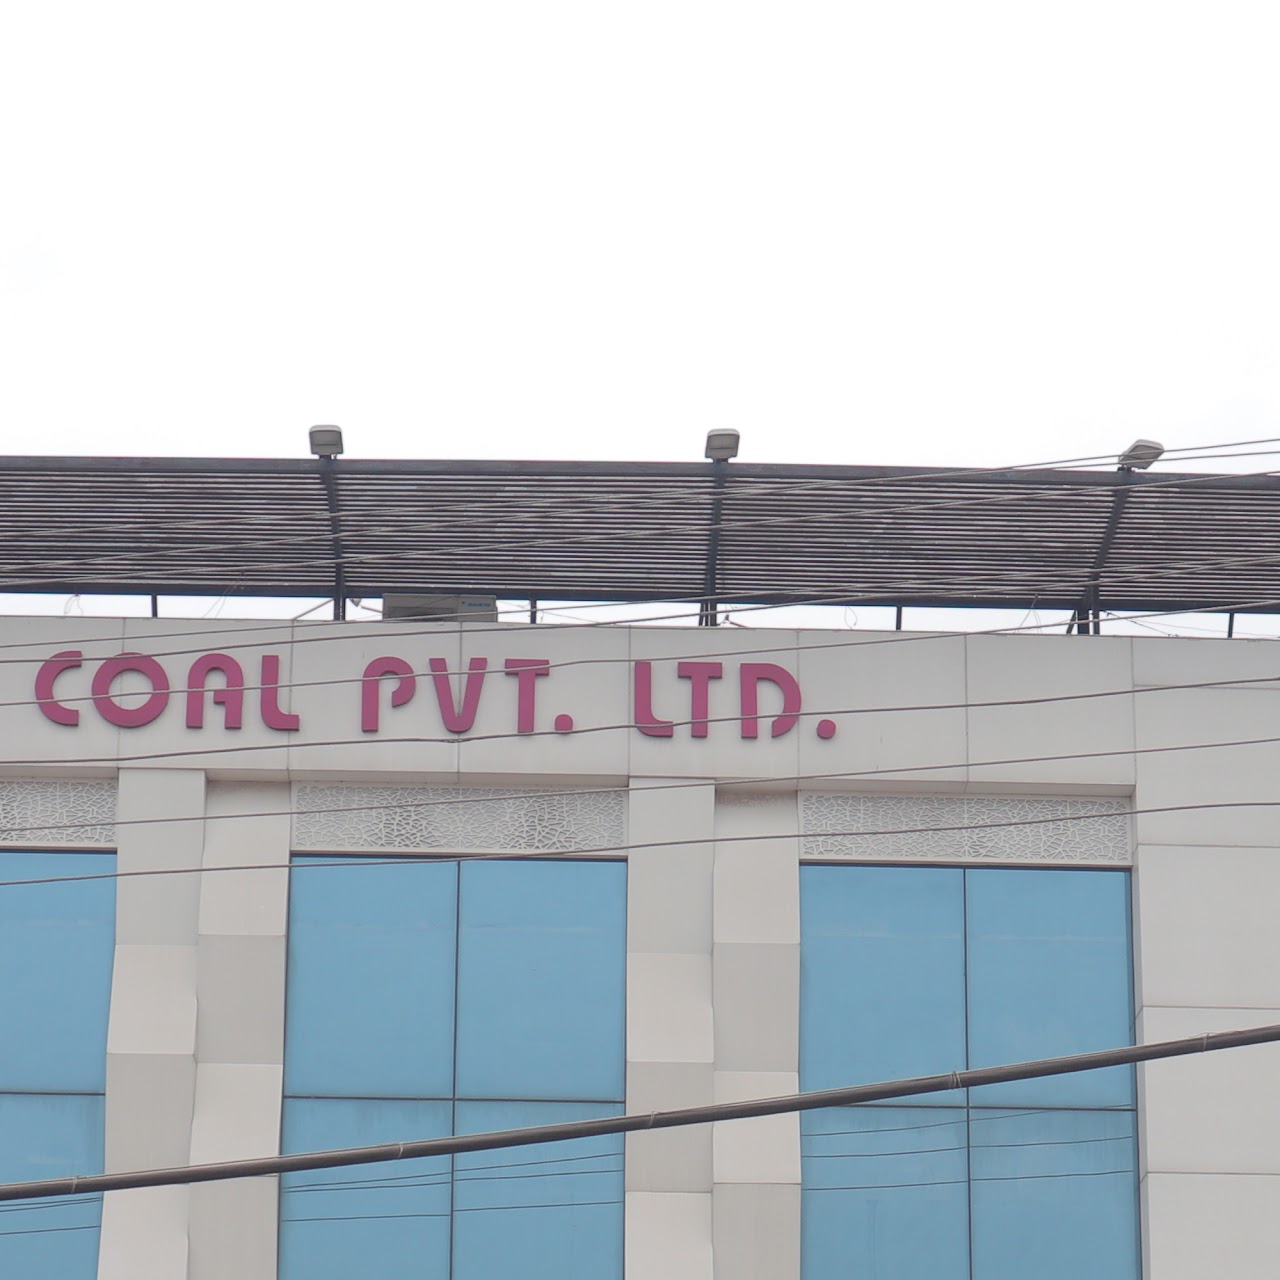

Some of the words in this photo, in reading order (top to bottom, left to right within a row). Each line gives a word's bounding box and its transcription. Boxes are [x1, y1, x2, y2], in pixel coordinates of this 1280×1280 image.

[35, 650, 300, 731] COAL
[361, 656, 573, 734] PVT.
[634, 661, 837, 740] LTD.
